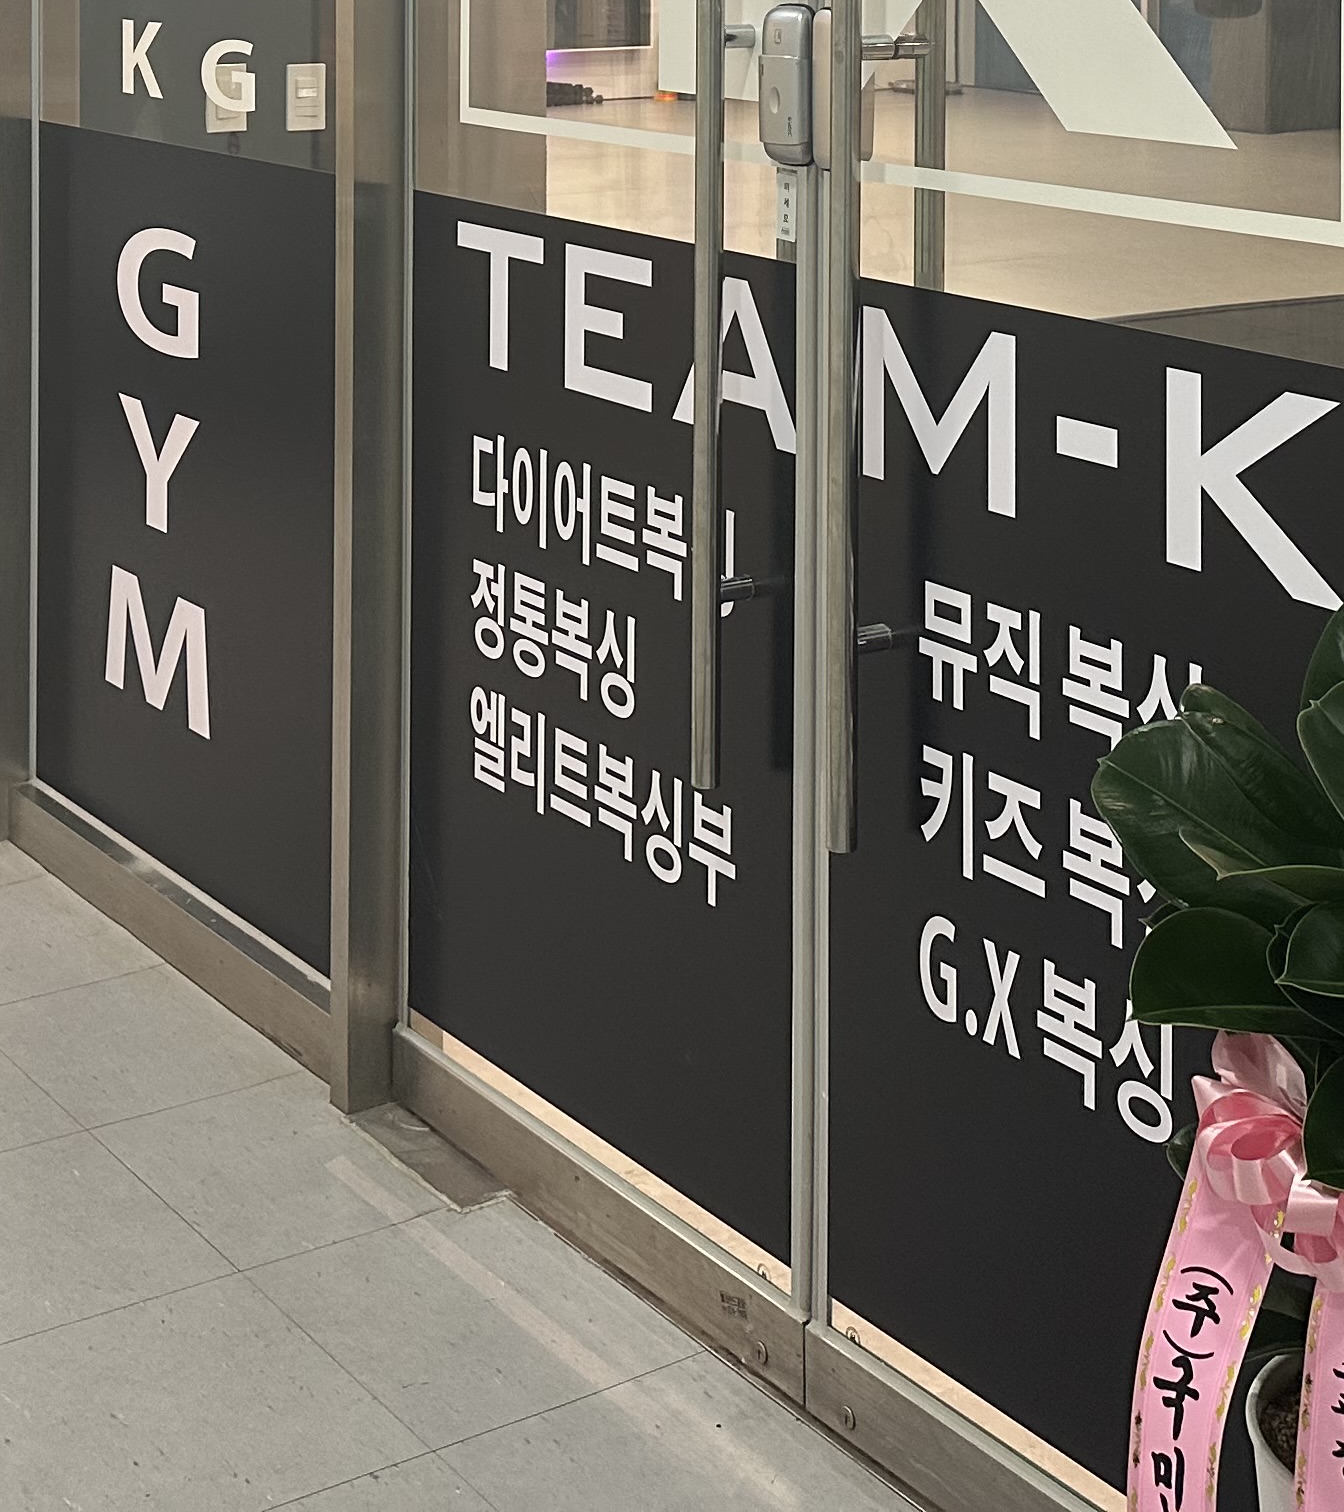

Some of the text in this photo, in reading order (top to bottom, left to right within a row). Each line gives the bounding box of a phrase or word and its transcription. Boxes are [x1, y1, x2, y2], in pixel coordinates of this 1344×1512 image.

[103, 226, 212, 741] GYM
[457, 220, 1343, 613] TEAM-K
[470, 557, 638, 721] 정통복싱
[918, 580, 1042, 742] 뮤직
[469, 685, 738, 909] 엘리트복싱부
[919, 744, 1158, 951] 키즈 복
[918, 914, 1175, 1145] G.X 복싱
